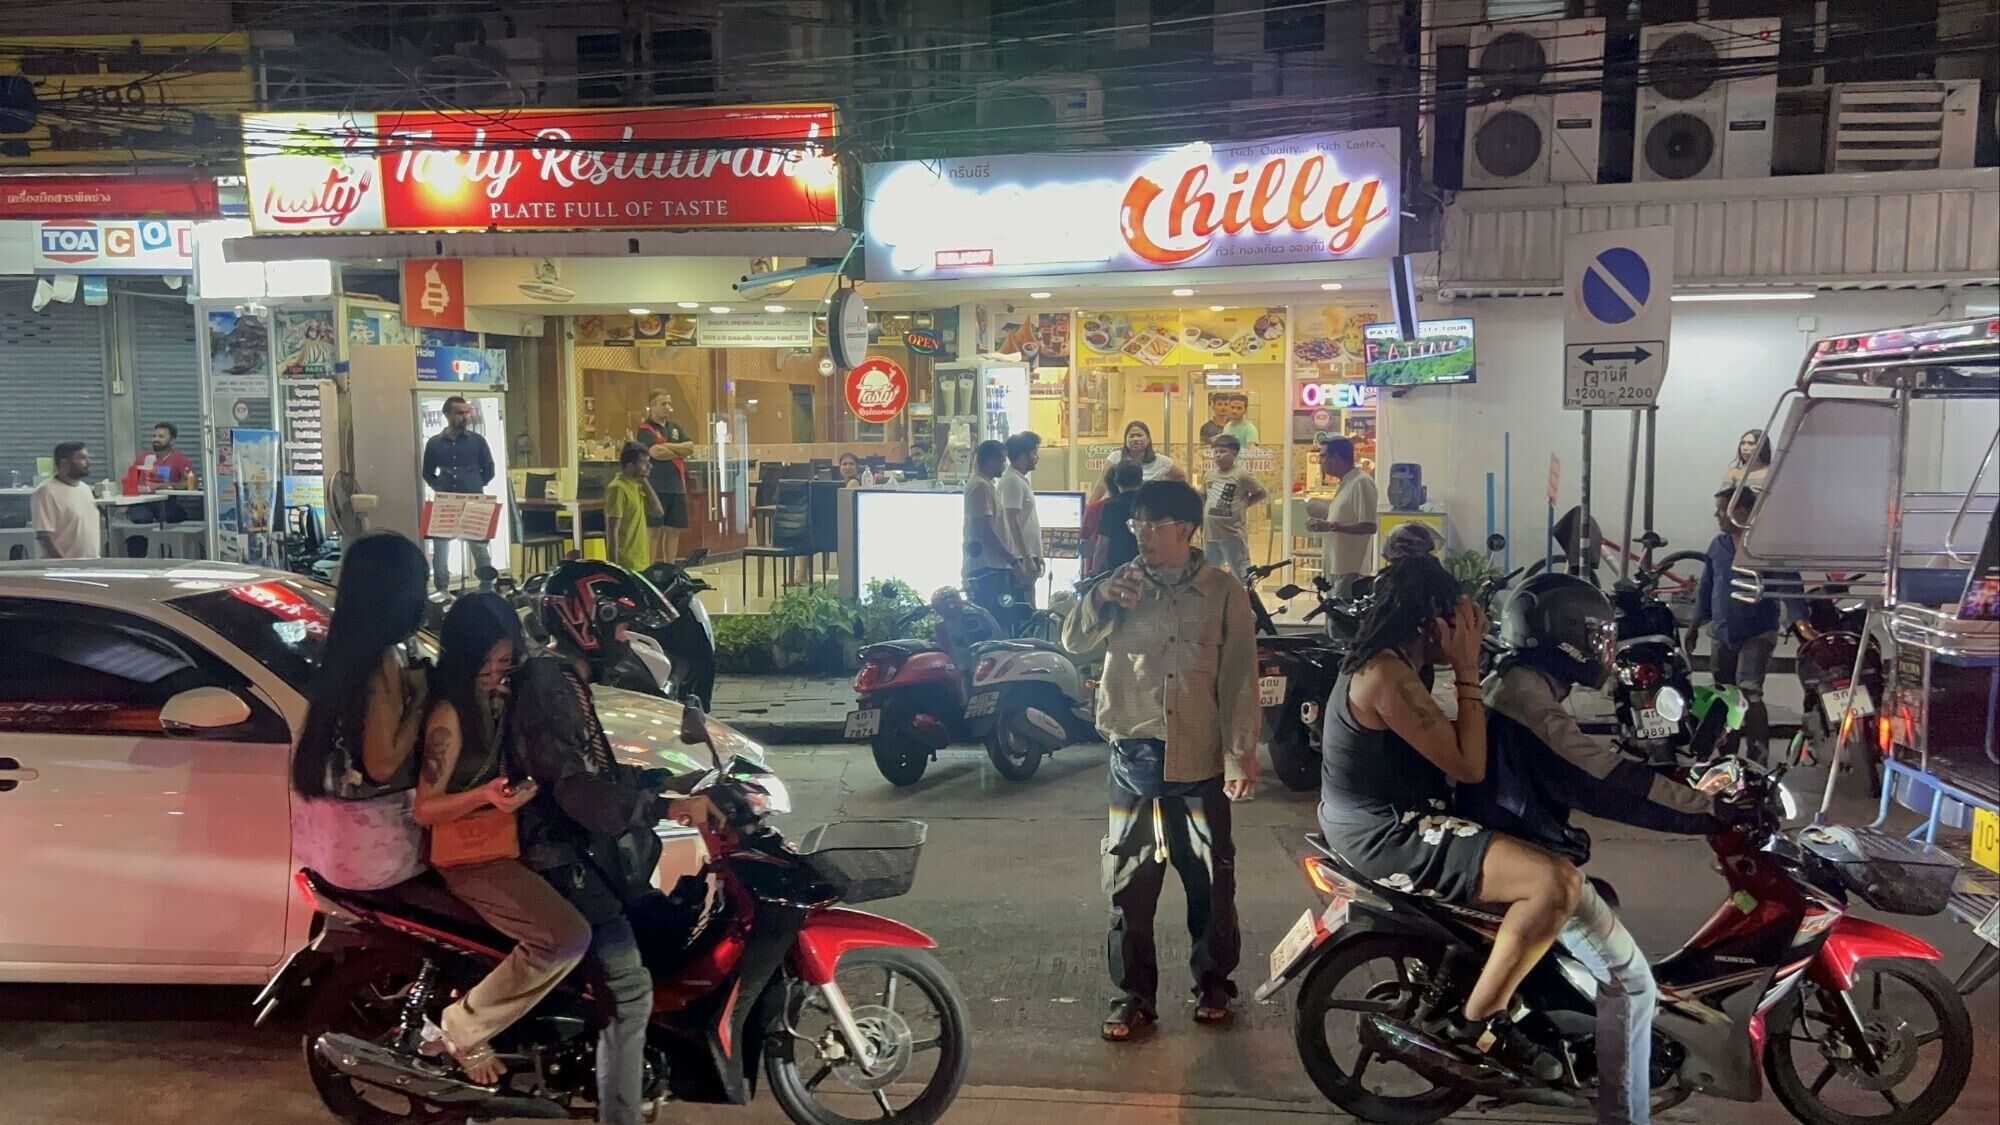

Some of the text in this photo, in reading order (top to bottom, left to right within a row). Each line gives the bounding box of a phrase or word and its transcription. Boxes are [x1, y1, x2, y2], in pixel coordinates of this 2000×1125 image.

[1317, 141, 1340, 152] Rich
[491, 199, 729, 219] PLATE FULL OF TASTE
[1120, 153, 1388, 265] Chilly
[43, 231, 96, 251] TOA
[908, 334, 939, 350] OPEN
[417, 348, 435, 358] Haier
[856, 384, 900, 408] Tasty
[1302, 383, 1365, 406] OPEN
[1643, 727, 1672, 736] 9891
[1714, 955, 1756, 964] HONDA
